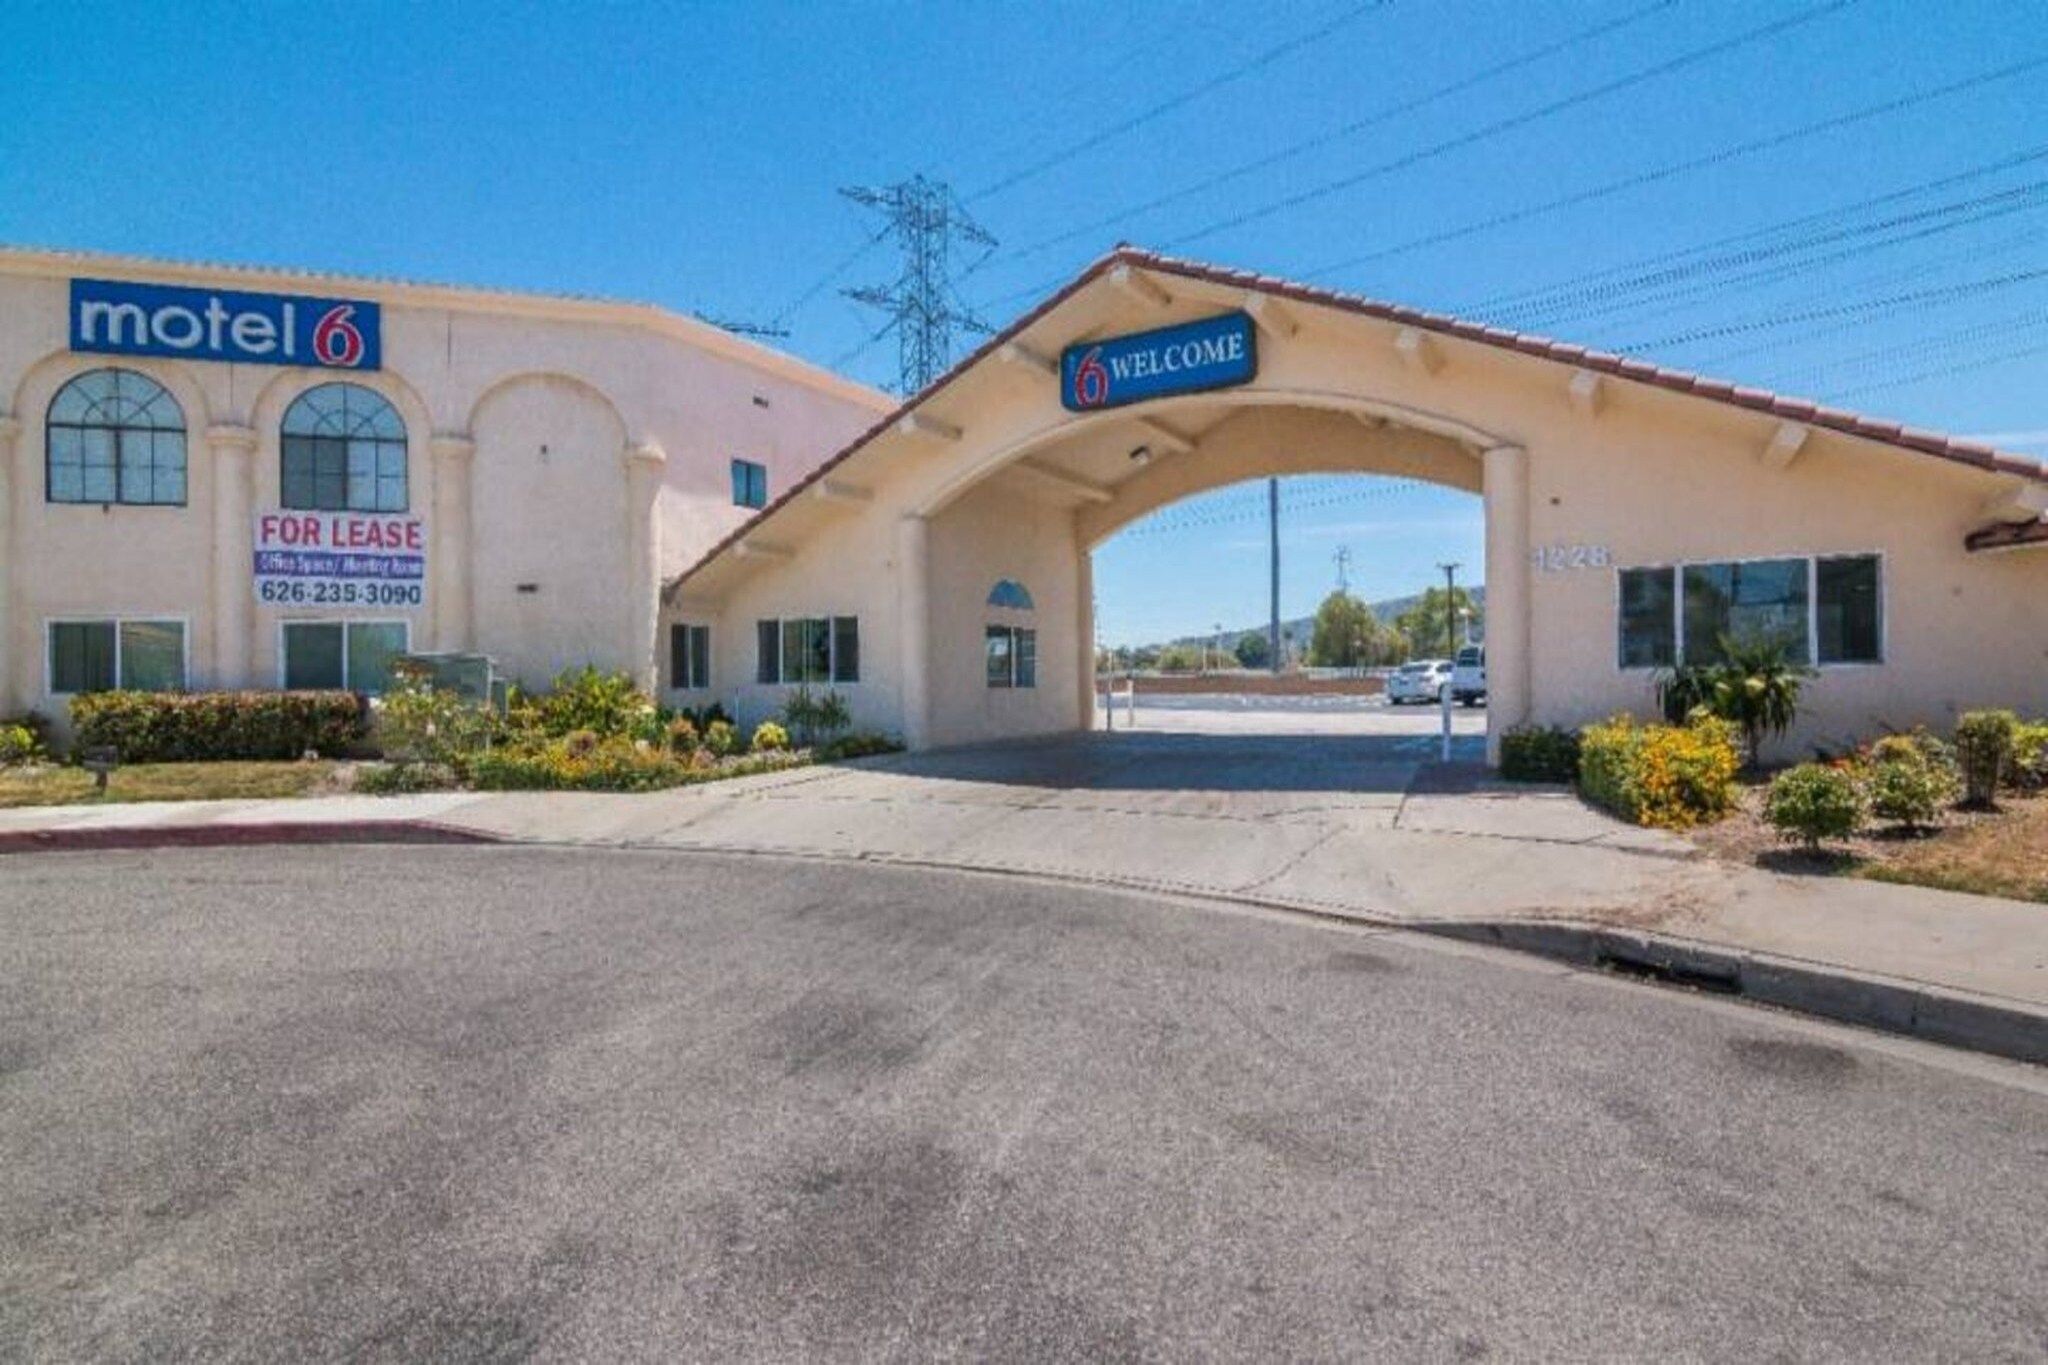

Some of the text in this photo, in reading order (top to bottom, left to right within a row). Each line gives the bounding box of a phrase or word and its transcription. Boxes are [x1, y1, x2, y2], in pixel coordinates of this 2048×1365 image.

[79, 297, 364, 367] motel 6
[1074, 332, 1244, 407] 6 WELCOME
[261, 515, 422, 549] FOR LEASE
